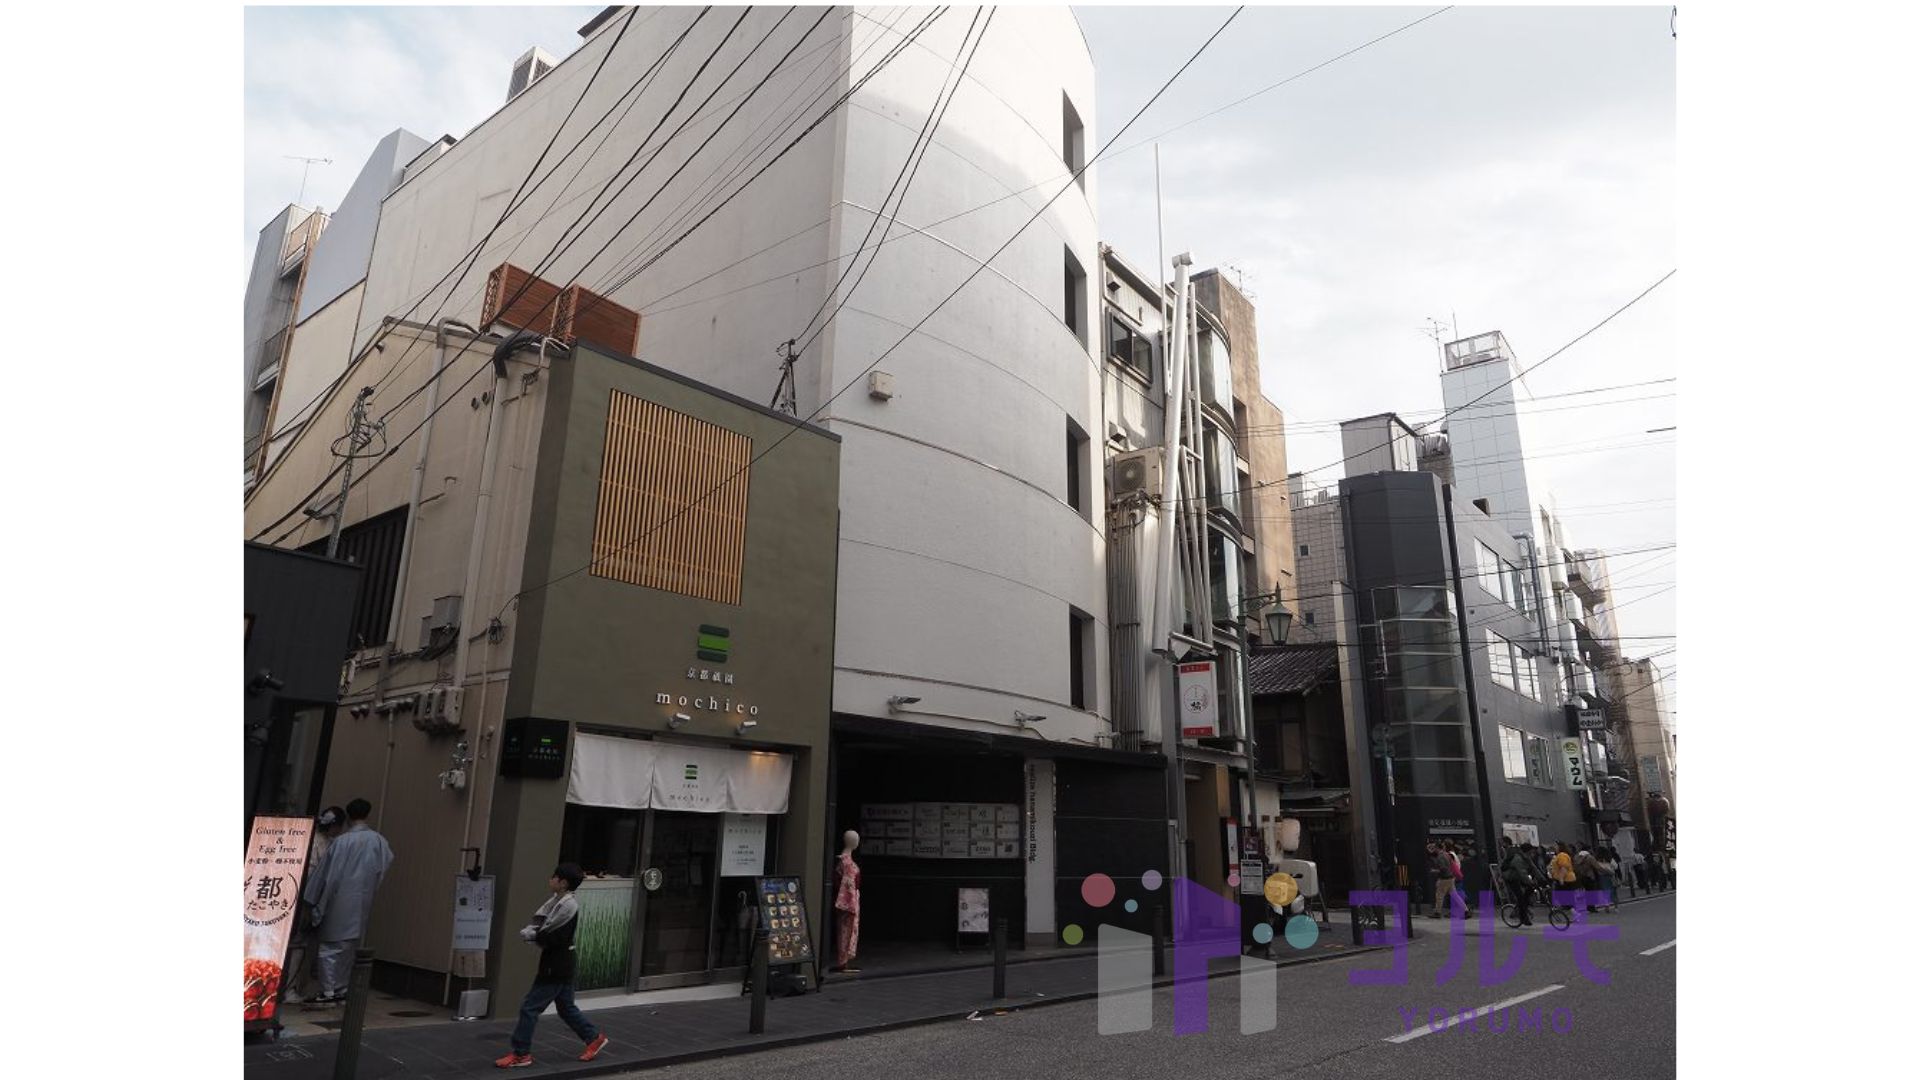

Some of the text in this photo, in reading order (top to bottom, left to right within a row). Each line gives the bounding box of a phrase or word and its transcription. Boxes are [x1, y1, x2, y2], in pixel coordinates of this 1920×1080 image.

[655, 692, 758, 715] mochico
[1568, 757, 1583, 786] マウム
[255, 827, 306, 836] Gluten free
[258, 845, 298, 854] Egg free
[247, 898, 289, 911] たこやき
